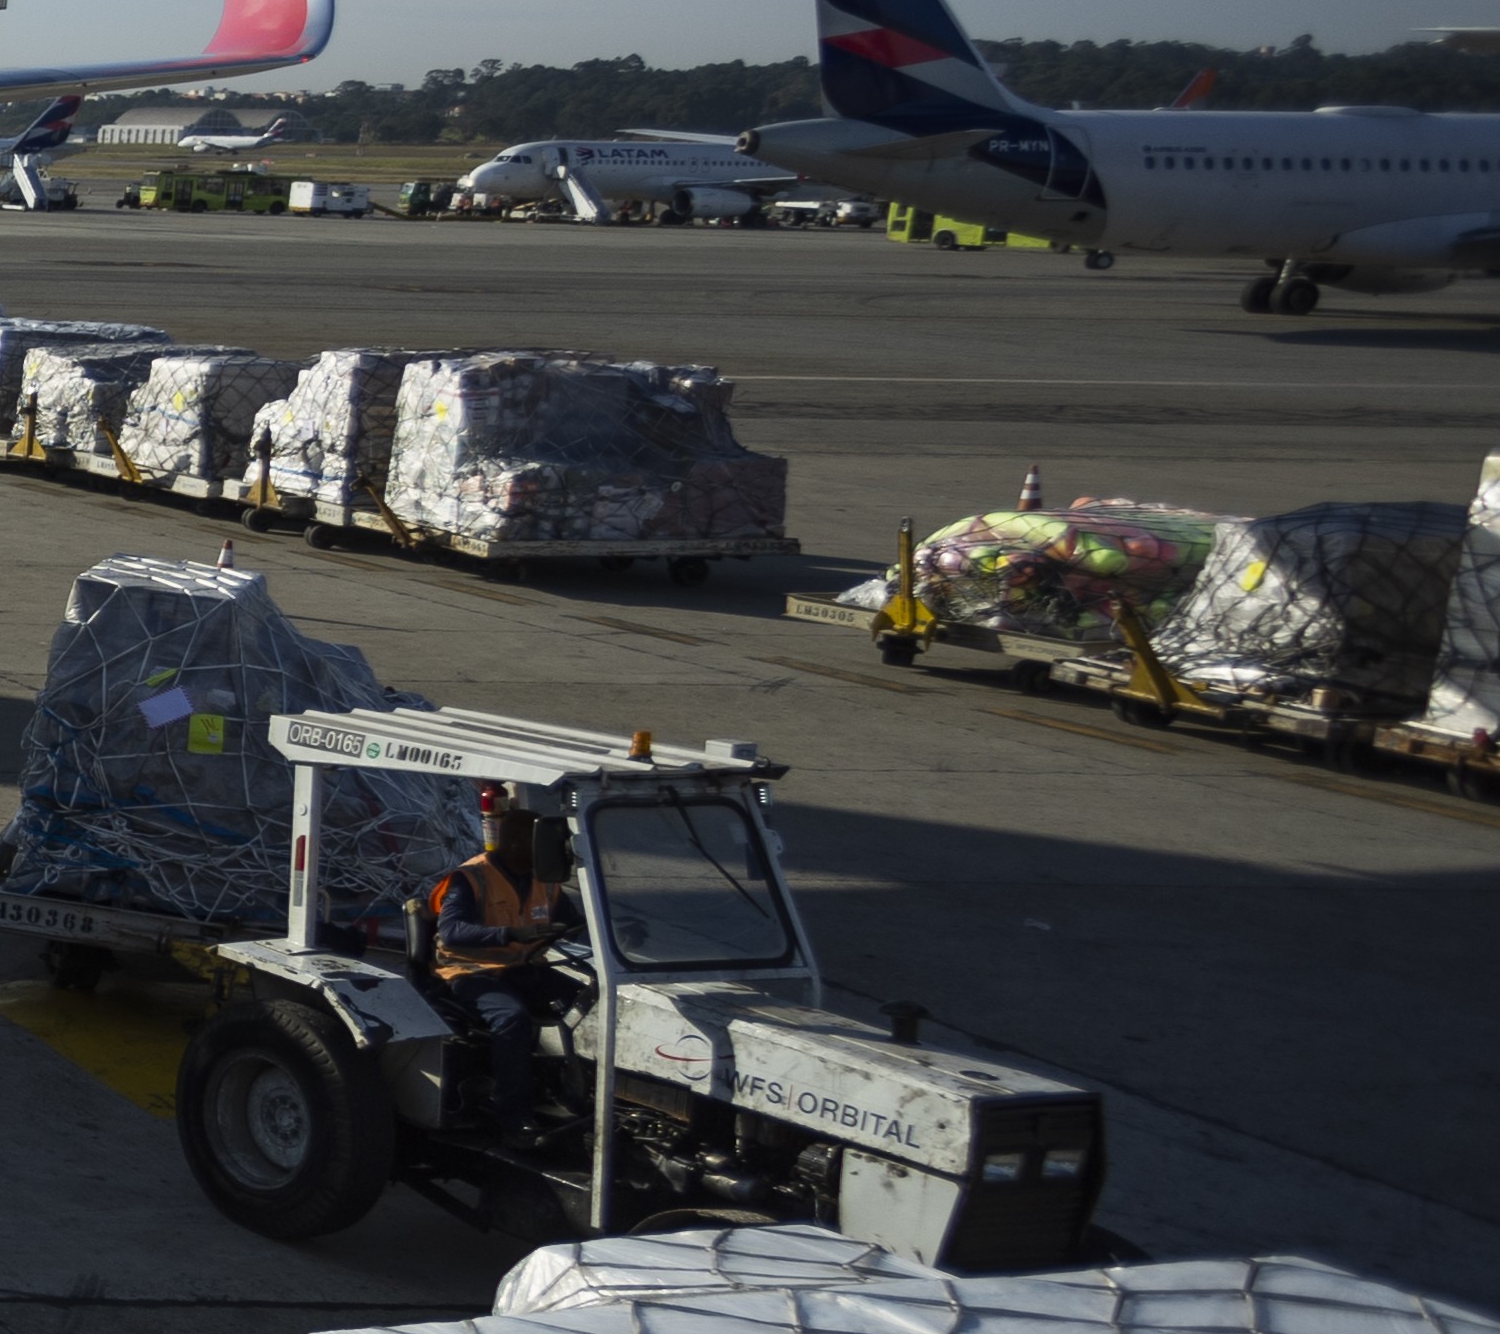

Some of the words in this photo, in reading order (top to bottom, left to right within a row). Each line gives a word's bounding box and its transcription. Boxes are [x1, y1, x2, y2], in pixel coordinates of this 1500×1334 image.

[597, 148, 669, 159] LATAM
[289, 723, 364, 755] ORB-0165
[797, 1092, 921, 1149] ORBITAL
